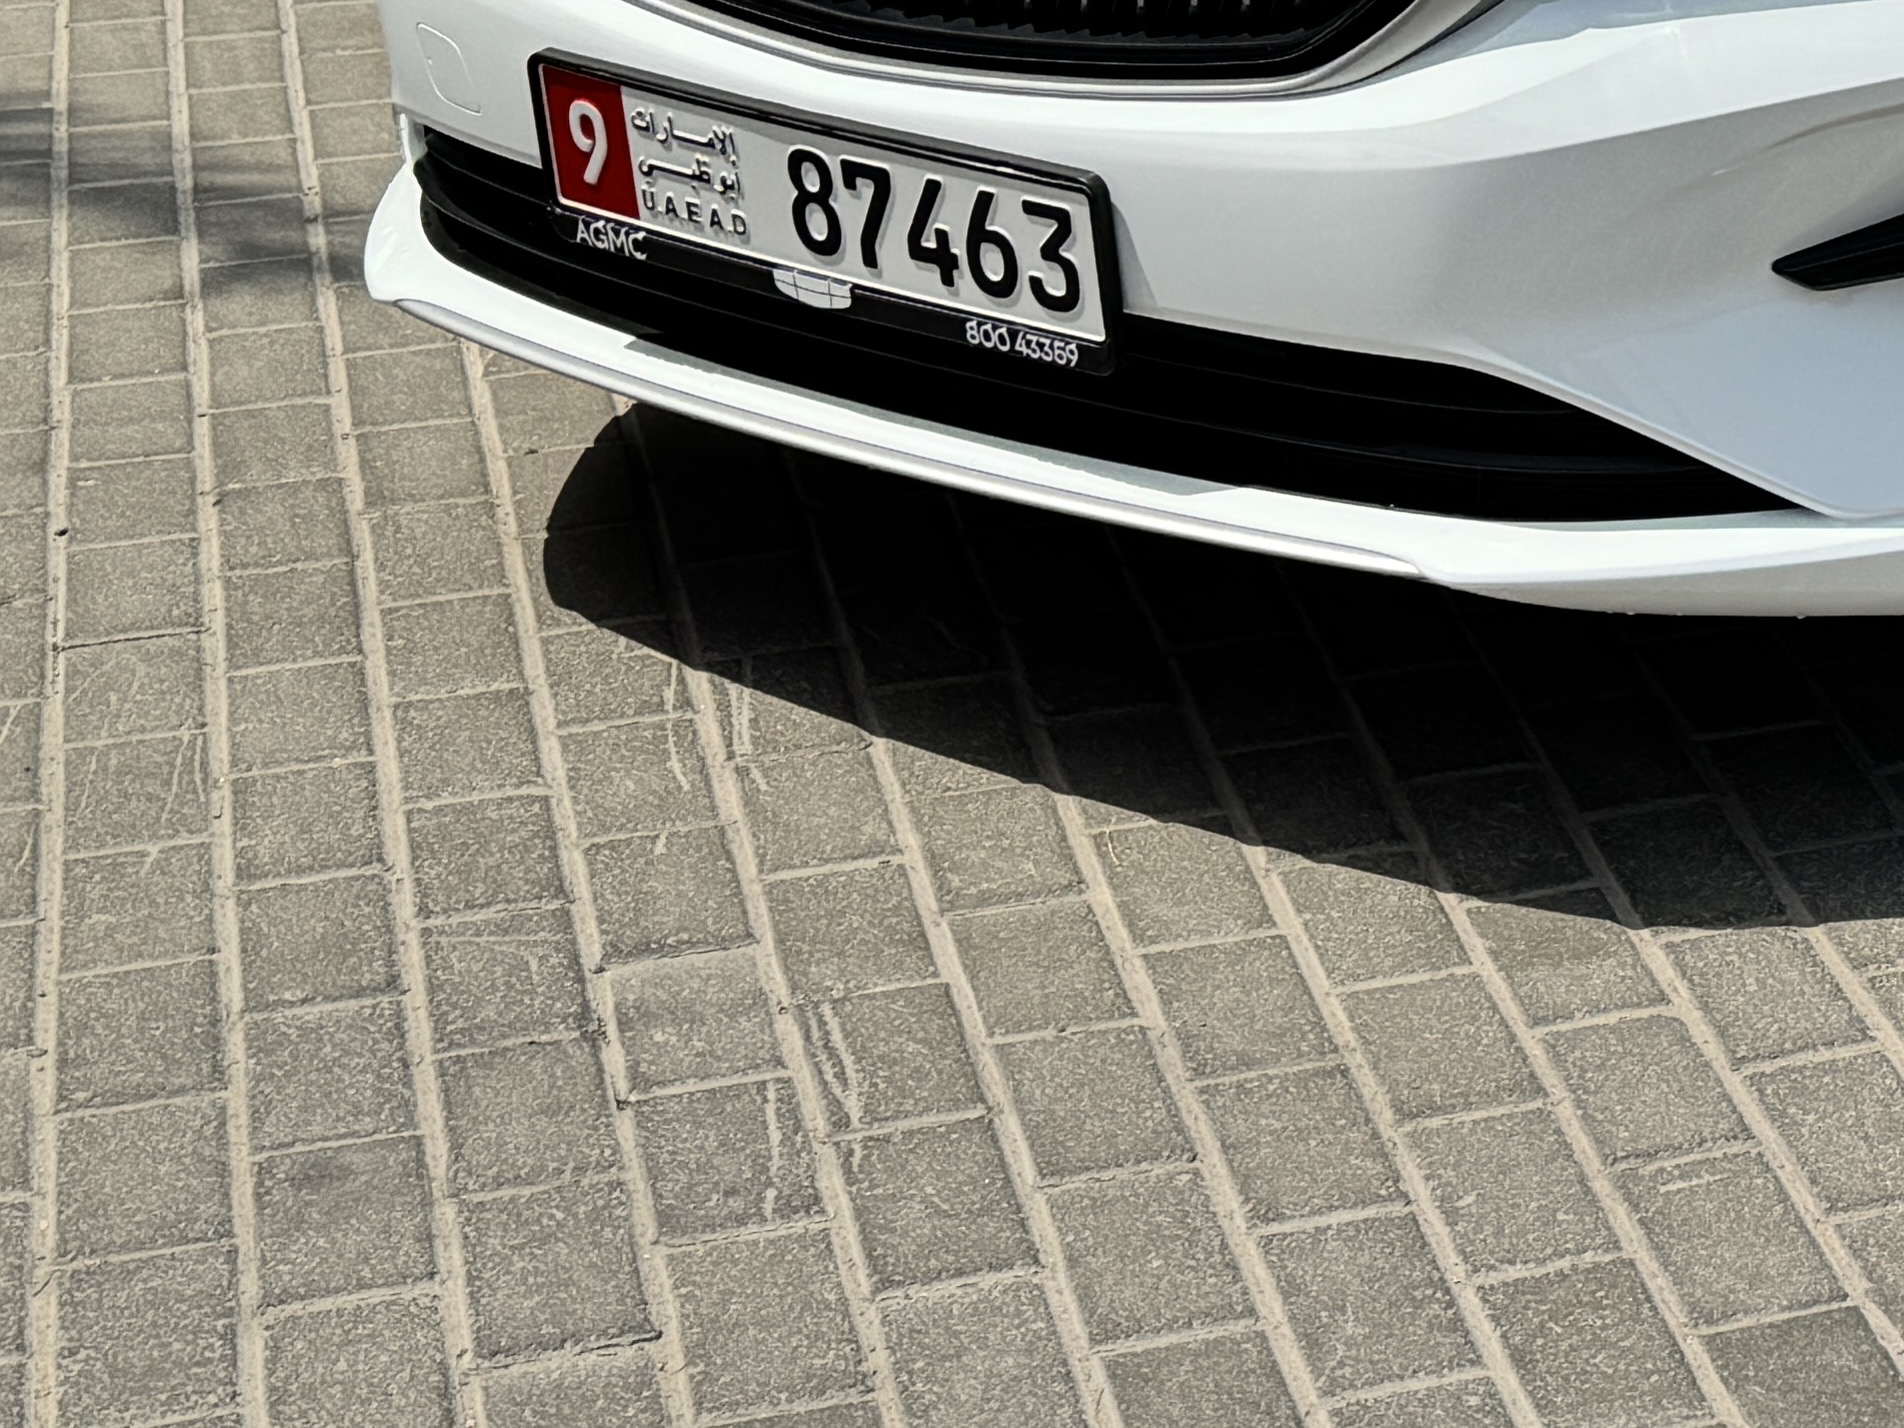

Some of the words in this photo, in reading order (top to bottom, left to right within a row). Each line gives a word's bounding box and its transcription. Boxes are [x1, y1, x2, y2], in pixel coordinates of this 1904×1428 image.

[568, 97, 609, 186] 9
[575, 215, 648, 261] AGMC
[786, 145, 1081, 313] 87463
[965, 319, 1011, 352] 800
